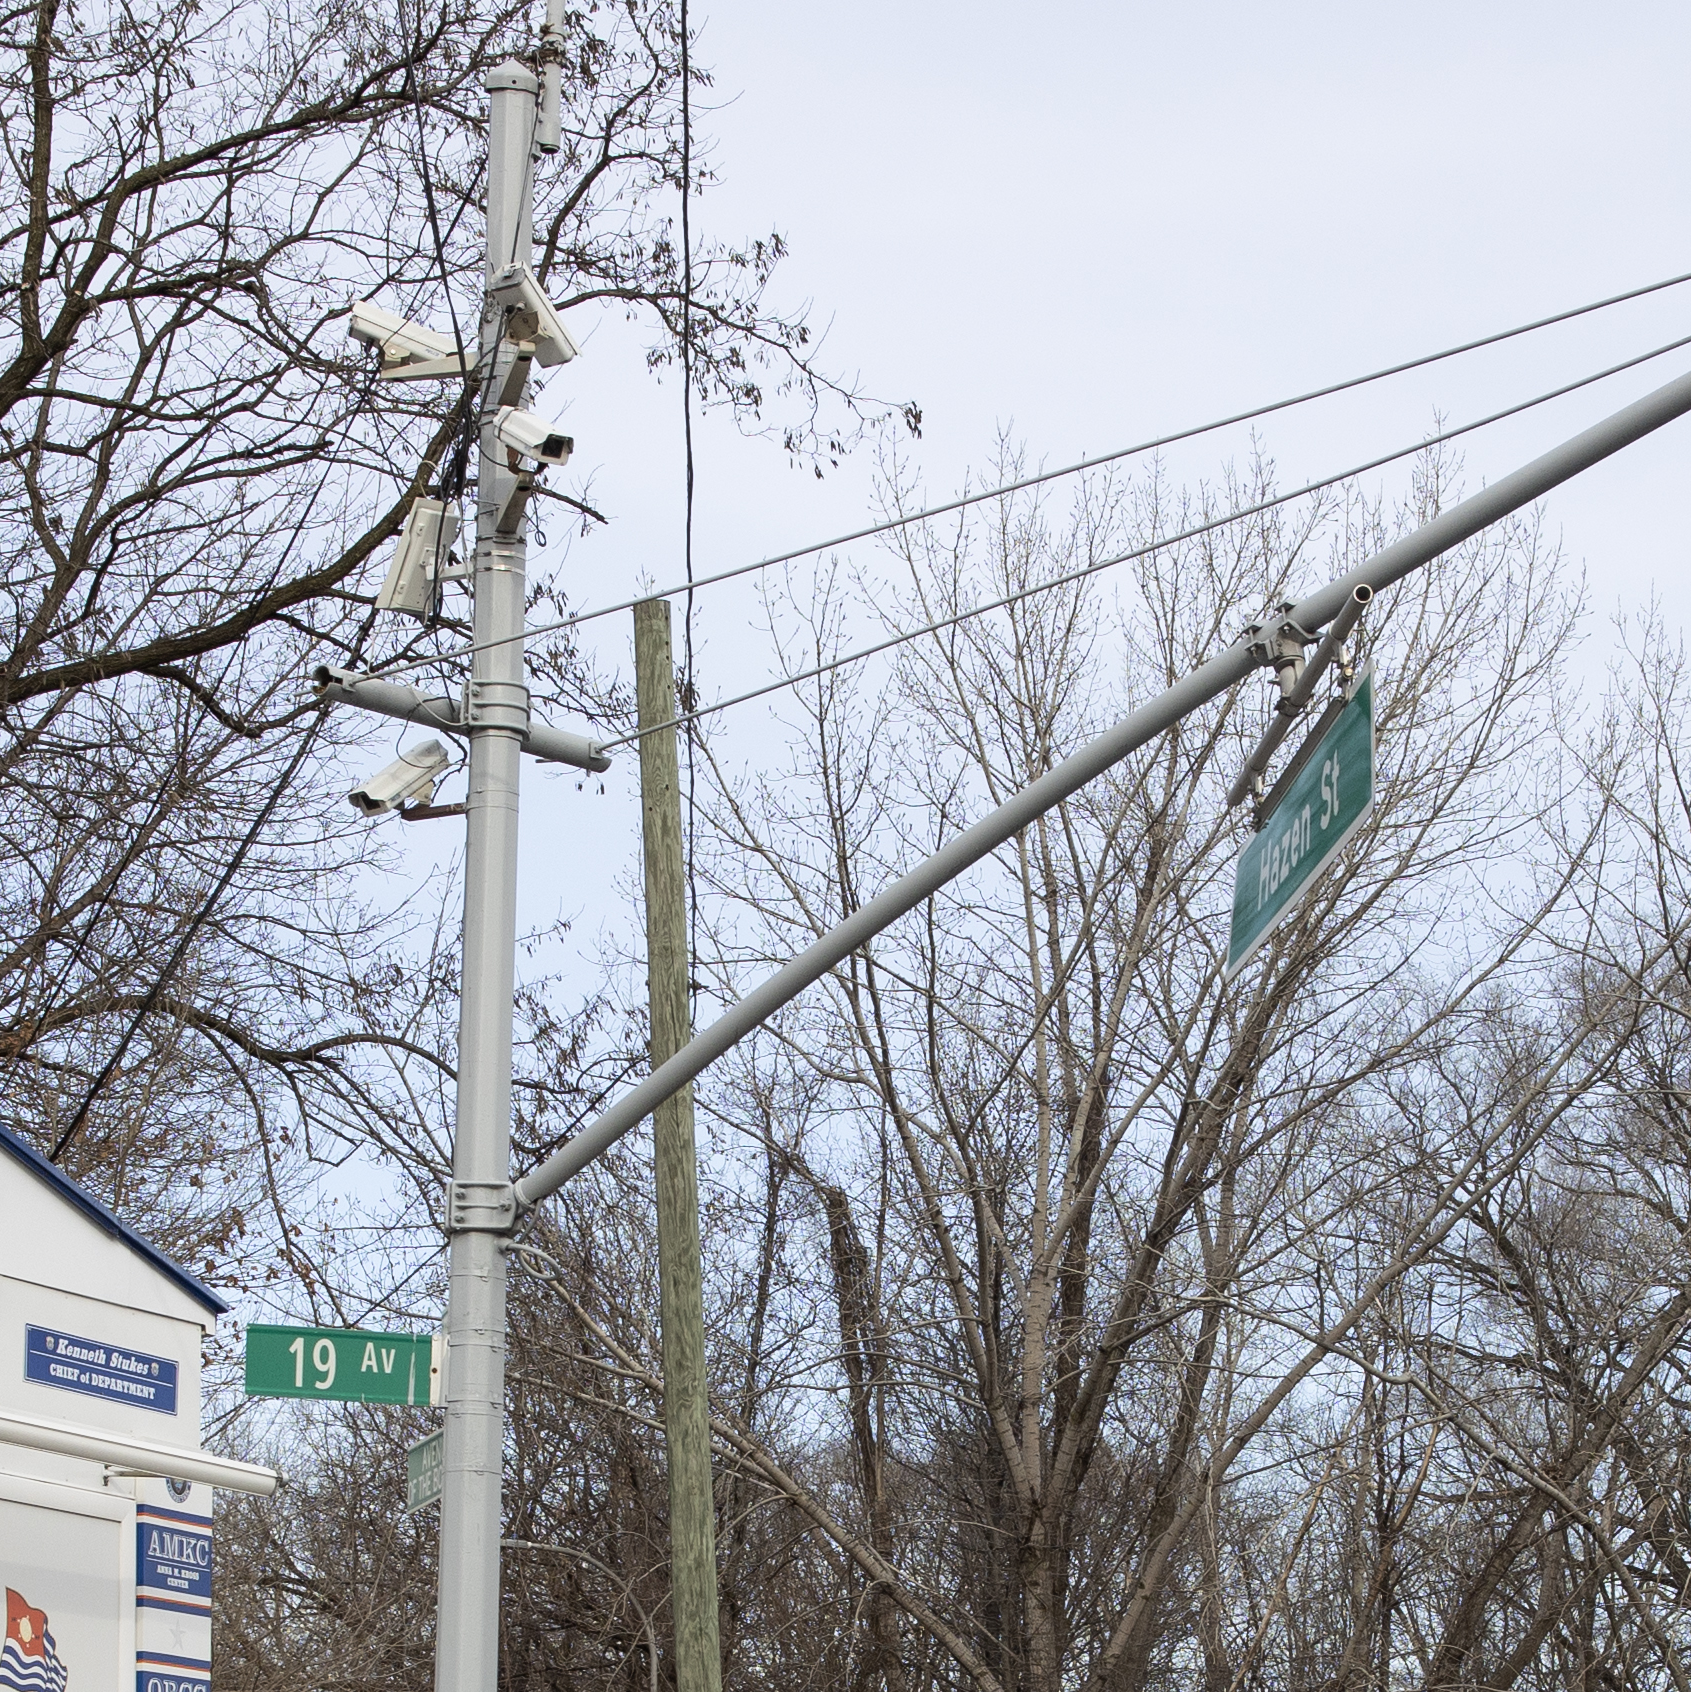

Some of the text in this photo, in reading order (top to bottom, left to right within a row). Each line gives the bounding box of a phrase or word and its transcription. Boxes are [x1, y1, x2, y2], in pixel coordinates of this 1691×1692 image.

[1258, 748, 1339, 911] Hazen St
[57, 1339, 149, 1375] Kenneth Stukes
[289, 1337, 336, 1390] 19
[49, 1363, 156, 1401] CHIEF of DEPARTMENT
[408, 1479, 417, 1506] OF
[418, 1471, 432, 1500] THE
[148, 1529, 209, 1566] AMKC
